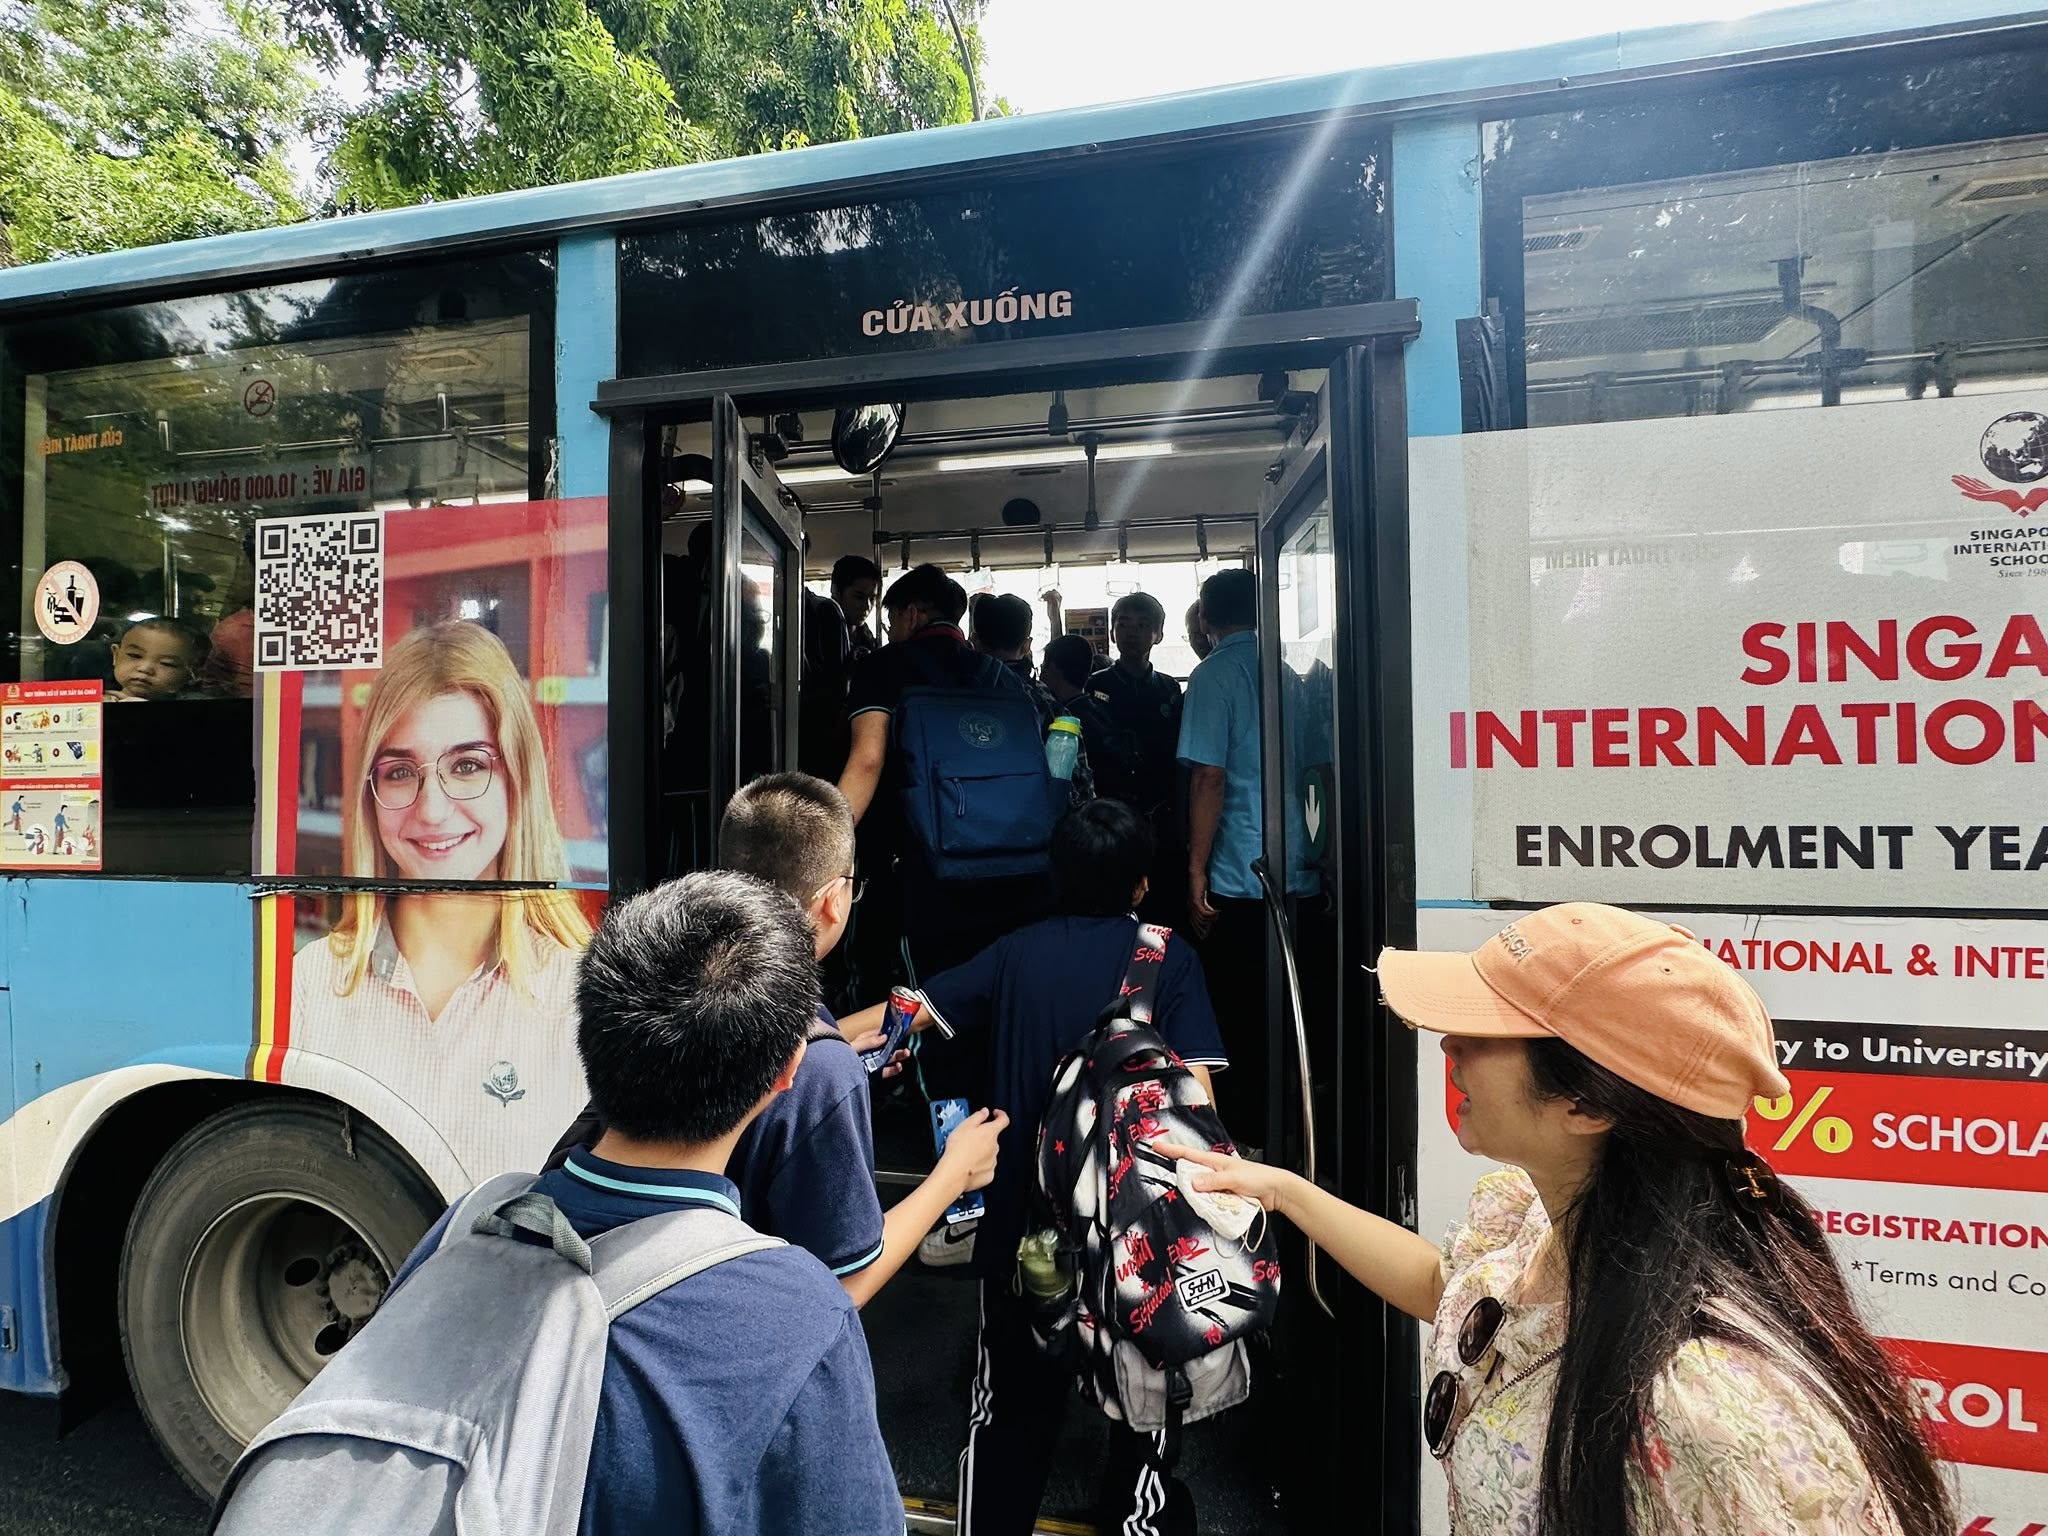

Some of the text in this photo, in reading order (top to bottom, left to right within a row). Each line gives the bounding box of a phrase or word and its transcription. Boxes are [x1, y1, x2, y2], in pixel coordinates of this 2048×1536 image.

[862, 286, 1072, 336] CỬA XUỐNG
[1953, 541, 2048, 555] INTERNATI
[1970, 527, 2048, 541] SINGAPO
[1990, 554, 2048, 567] SCHOO
[1998, 568, 2048, 578] Since 198
[1740, 614, 2048, 686] SINGA
[1449, 698, 2048, 769] INTERNATION
[1516, 824, 1913, 870] ENROLMENT
[1703, 938, 2048, 979] ATIONAL & INTE
[1814, 1037, 1849, 1061] to
[1862, 1036, 2048, 1077] University
[1949, 1269, 1997, 1293] and
[2008, 1273, 2047, 1297] Co
